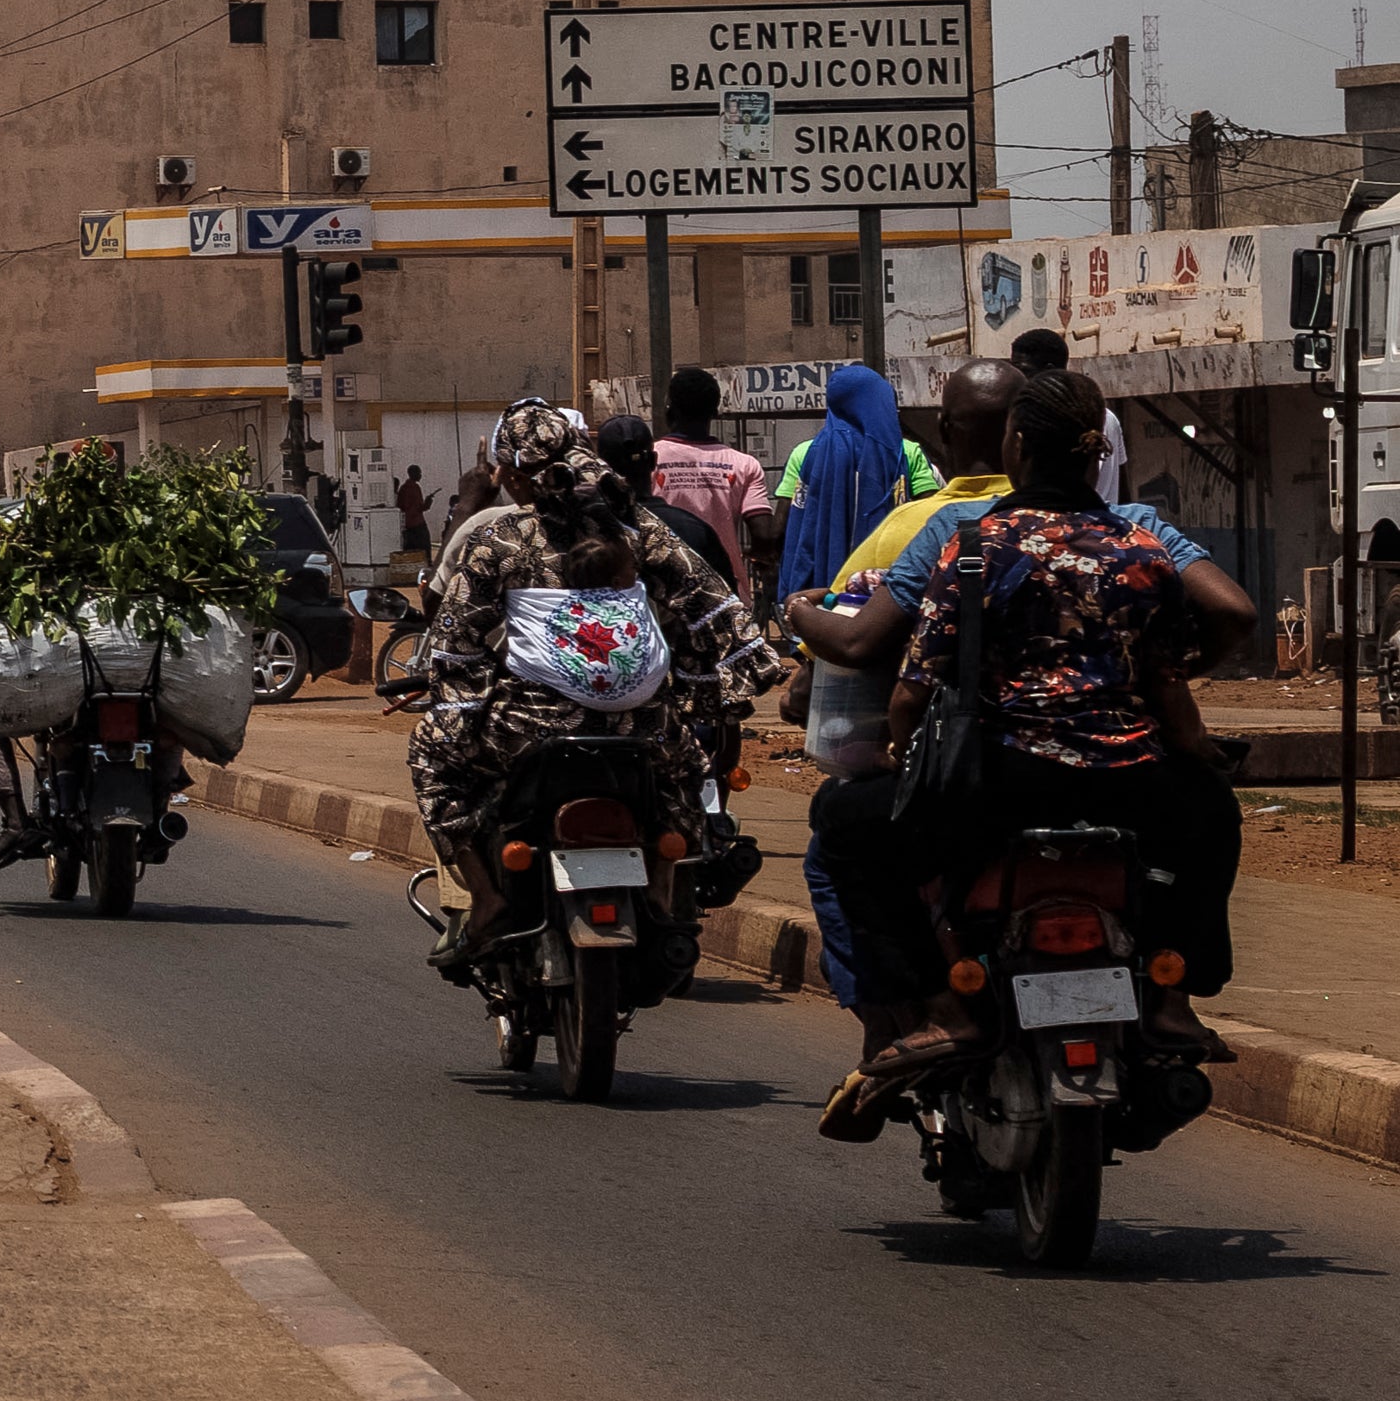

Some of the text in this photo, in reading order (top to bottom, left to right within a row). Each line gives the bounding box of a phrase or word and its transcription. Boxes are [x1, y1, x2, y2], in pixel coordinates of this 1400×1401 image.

[709, 18, 960, 52] CENTRE-VILLE
[670, 57, 962, 91] BACODJICORONI
[794, 122, 967, 154] SIRAKORO
[606, 161, 969, 198] LOGEMENTS SOCIAUX
[747, 395, 784, 412] AUTO
